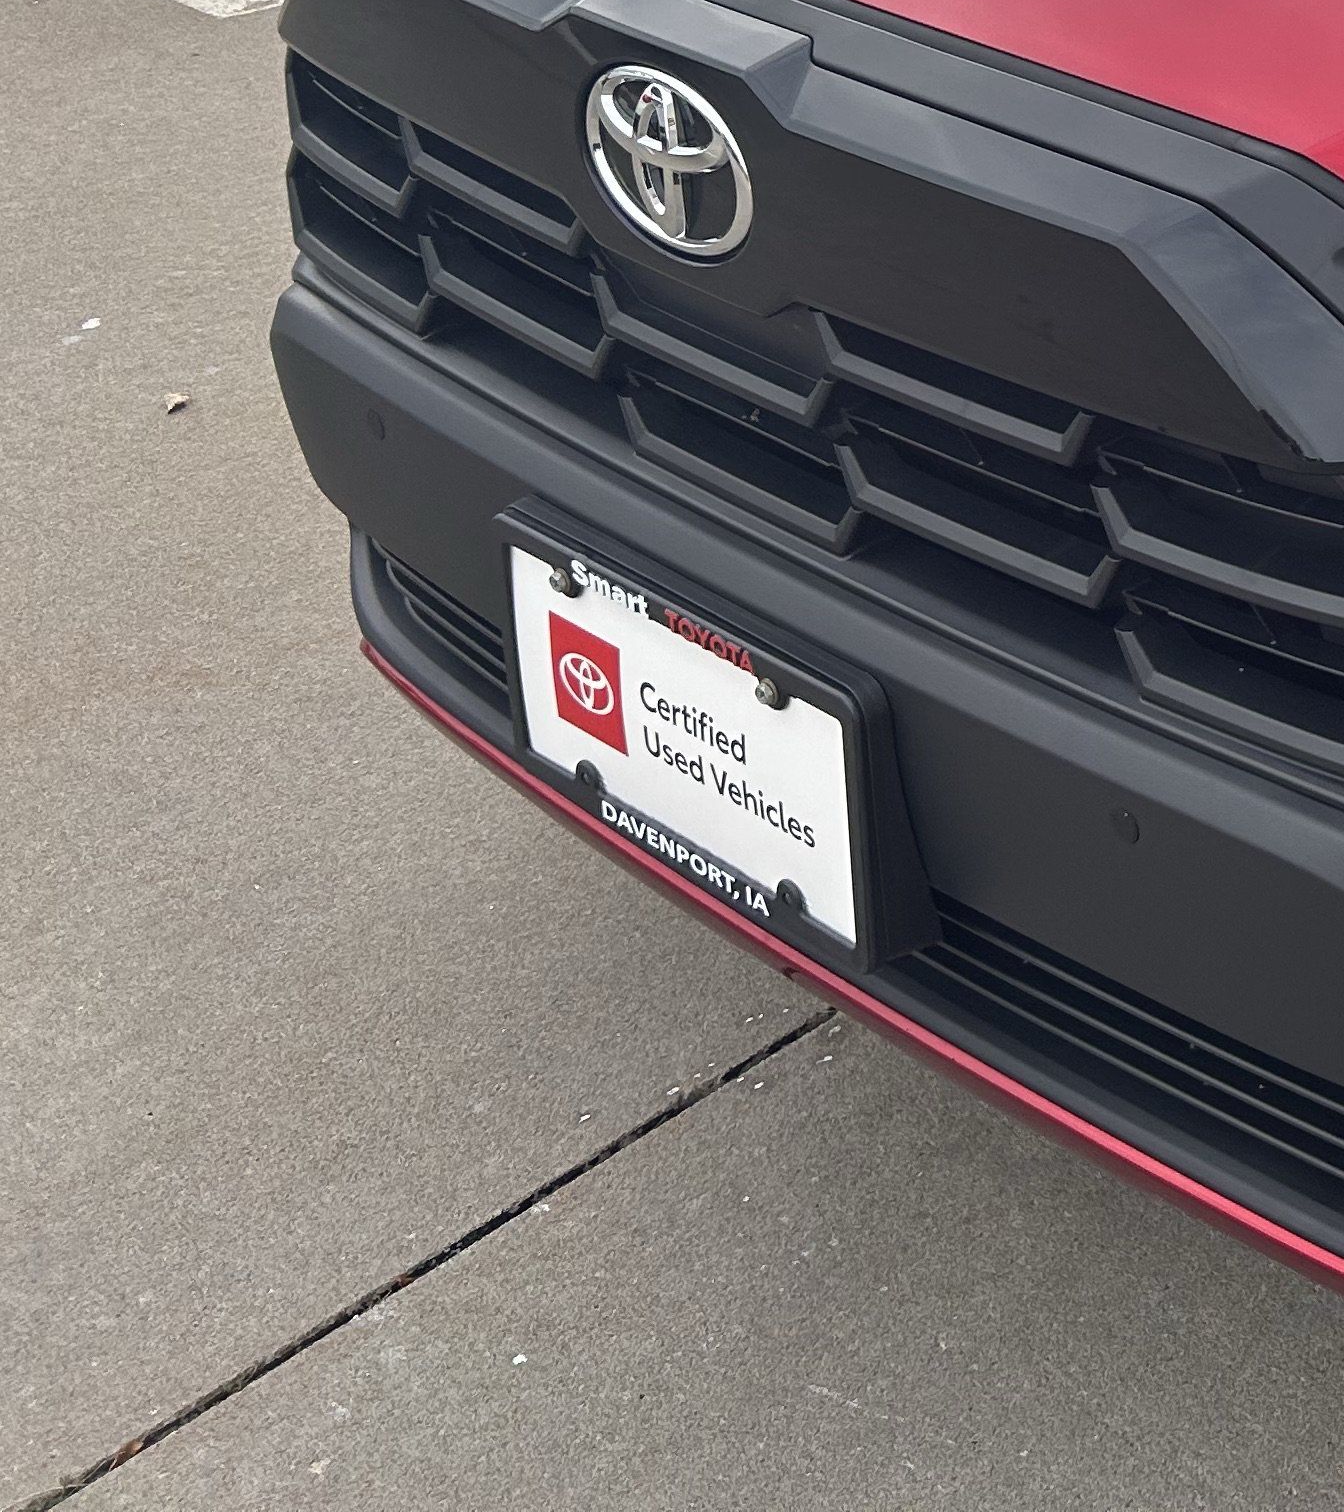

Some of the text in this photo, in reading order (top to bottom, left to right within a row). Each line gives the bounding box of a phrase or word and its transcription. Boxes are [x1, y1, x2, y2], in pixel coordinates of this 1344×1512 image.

[570, 559, 756, 675] Smart TOYOTA
[640, 682, 747, 765] Certified
[643, 725, 816, 848] Used Vehicles
[601, 800, 771, 917] DAVENPORT, IA
